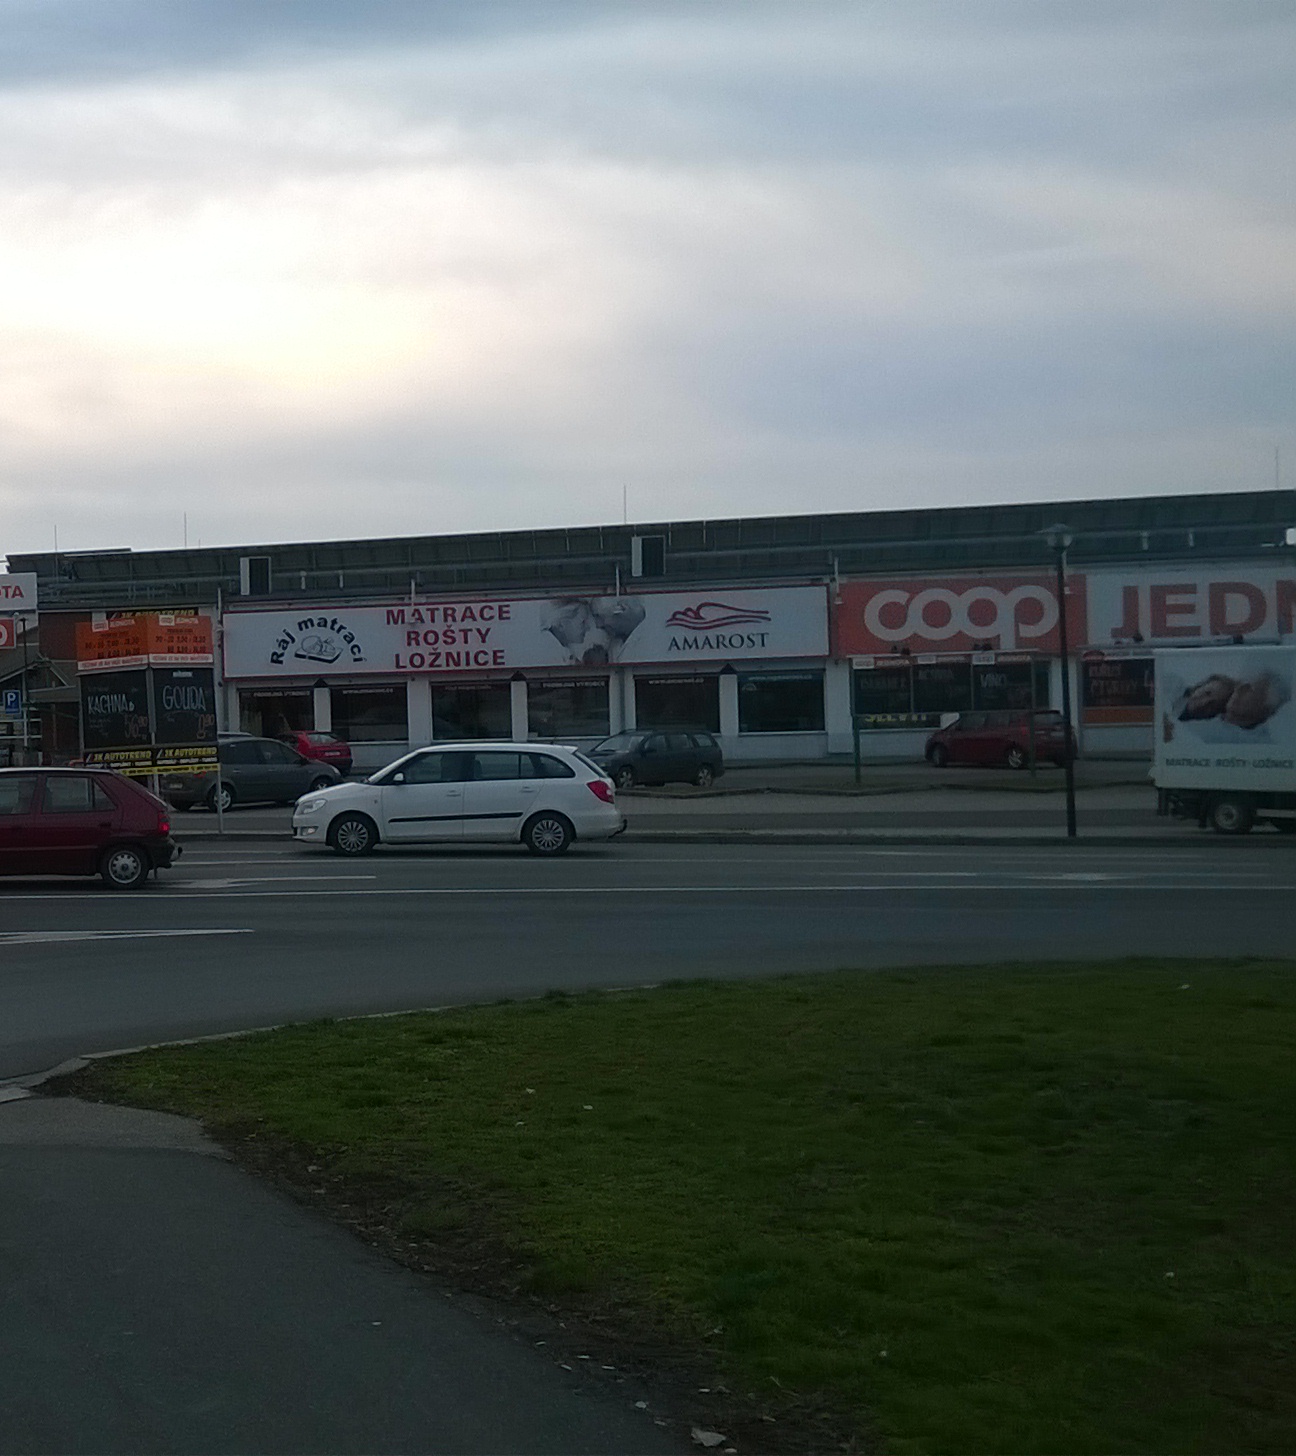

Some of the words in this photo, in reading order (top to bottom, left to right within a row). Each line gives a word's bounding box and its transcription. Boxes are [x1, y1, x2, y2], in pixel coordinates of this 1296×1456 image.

[386, 604, 511, 626] MATRACE
[406, 624, 491, 647] ROŠTY
[668, 632, 769, 651] AMAROST
[395, 647, 505, 669] LOŽNICE
[88, 694, 128, 714] KACHNA
[163, 685, 206, 711] GOUDA
